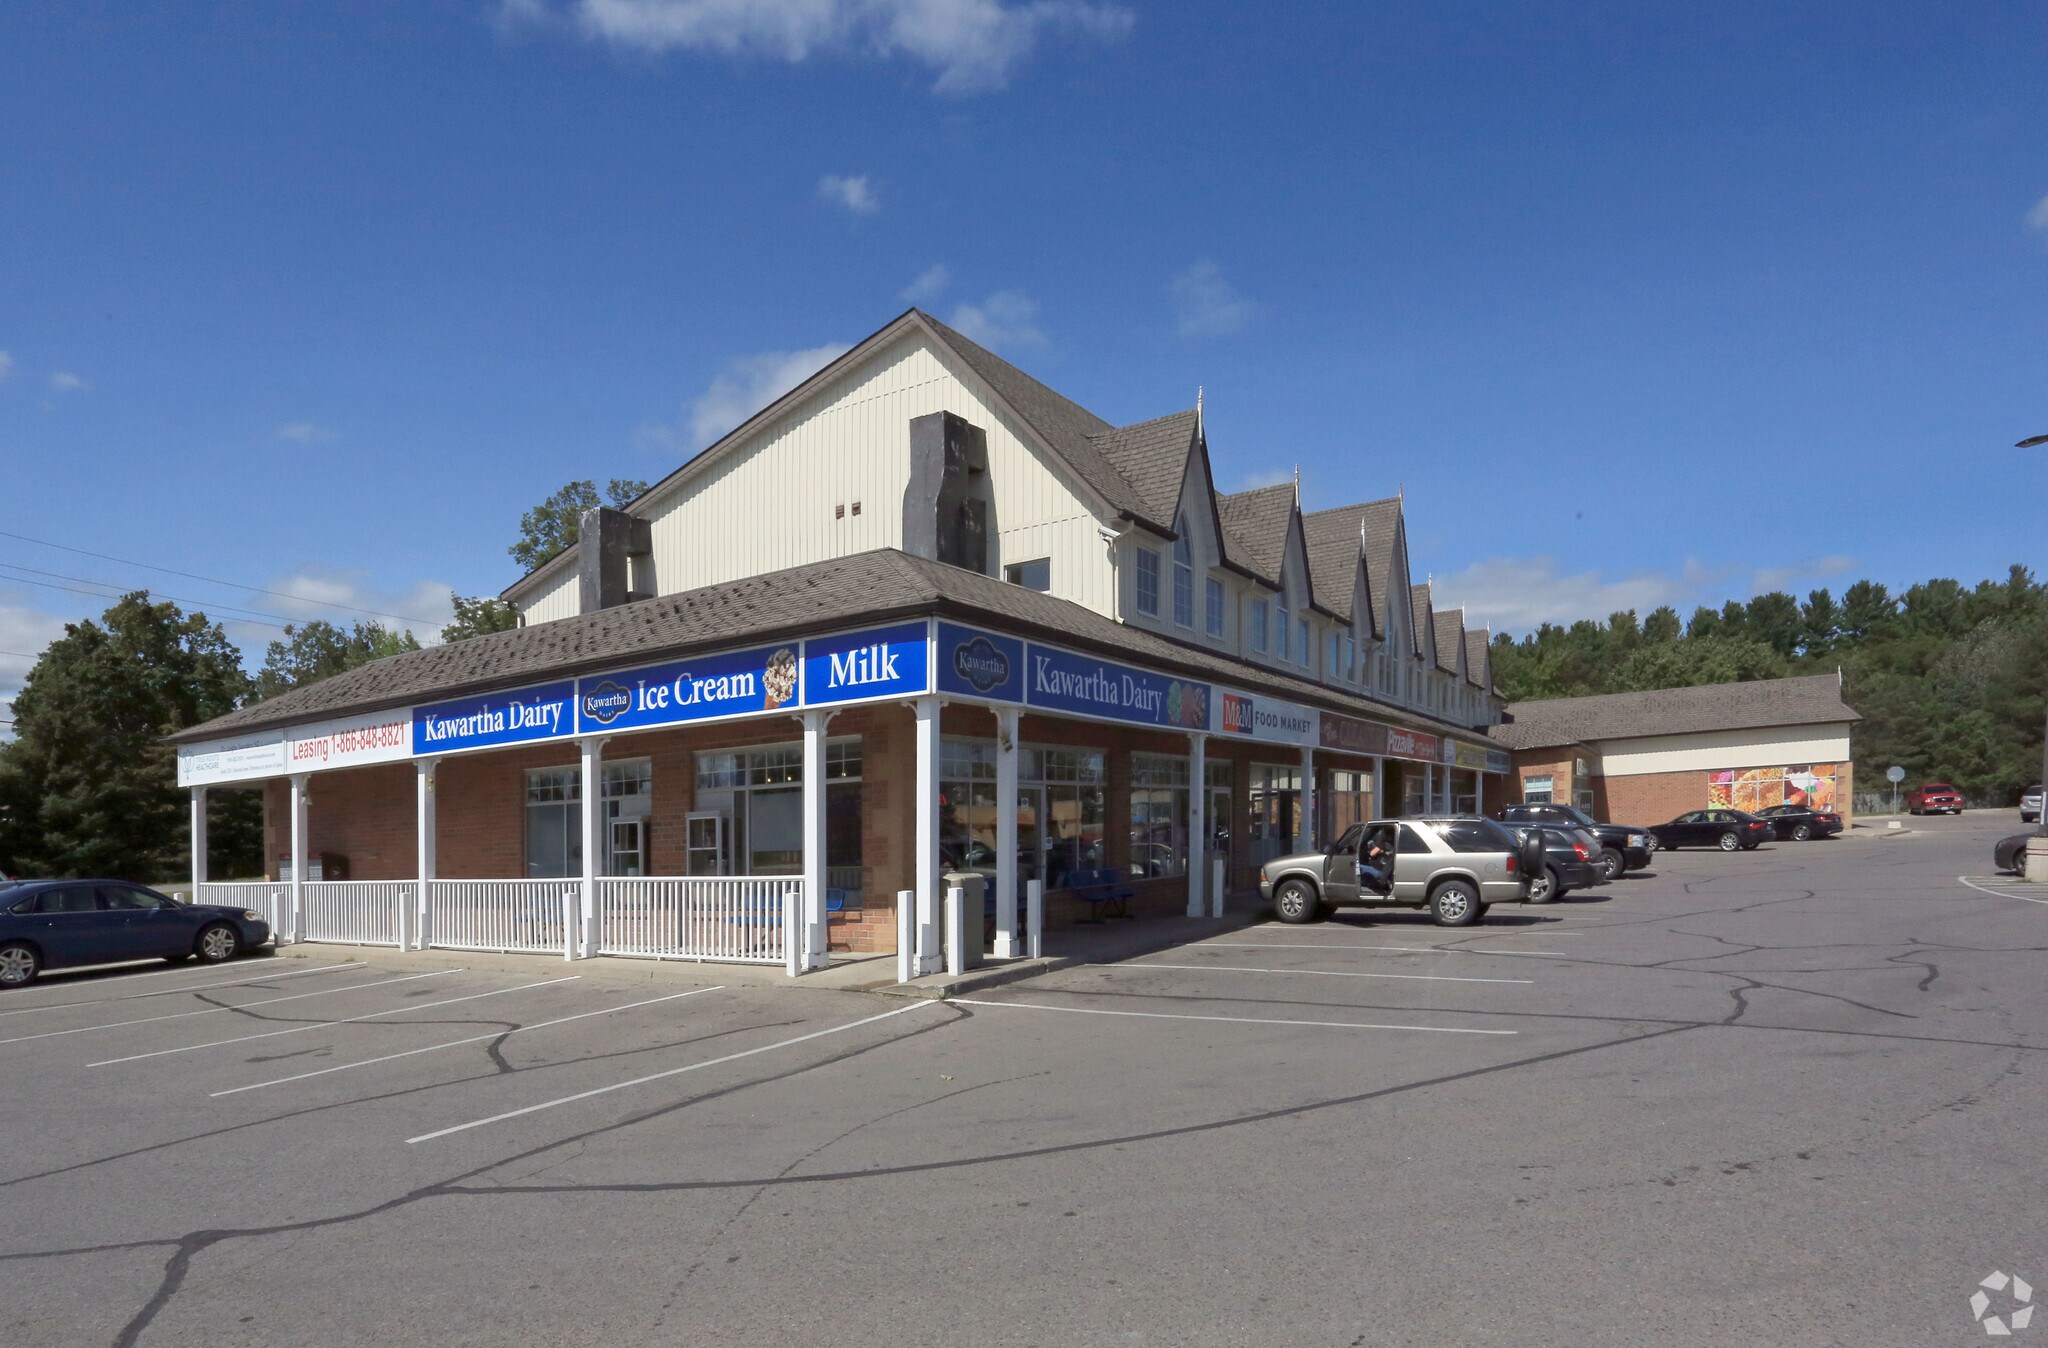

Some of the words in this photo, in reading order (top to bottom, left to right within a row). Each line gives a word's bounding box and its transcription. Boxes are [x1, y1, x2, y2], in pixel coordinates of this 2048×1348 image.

[828, 642, 900, 689] Milk
[959, 651, 1005, 674] Kawartha
[587, 693, 627, 711] Kawartha
[637, 680, 670, 712] Ice
[674, 672, 756, 703] Cream
[1035, 655, 1119, 705] Kawartha
[1121, 675, 1163, 722] Dairy
[424, 713, 504, 742] Kawartha
[509, 696, 563, 734] Dairy
[1225, 699, 1251, 728] M&M
[1255, 711, 1278, 728] FOOD
[1280, 716, 1311, 734] MARKET
[293, 735, 328, 762] Leasing
[331, 721, 405, 754] 1-866-848-8821
[1388, 729, 1415, 755] Pizzaville
[1528, 794, 1549, 803] AXIS
